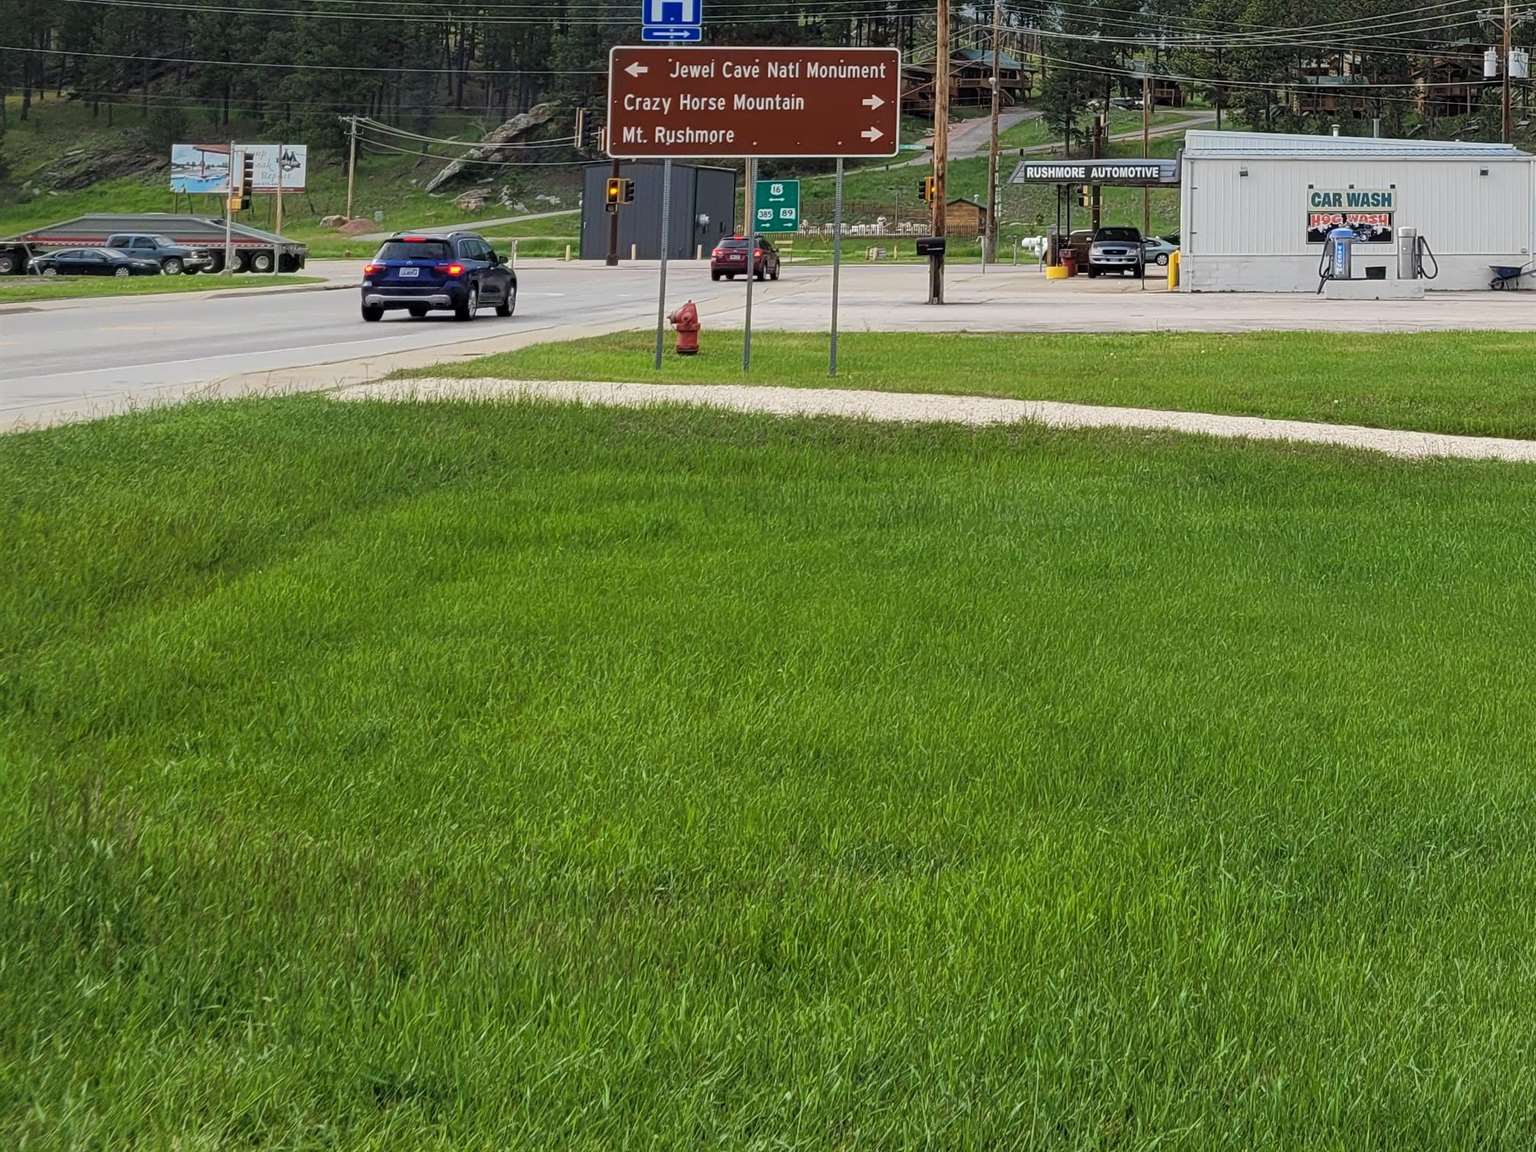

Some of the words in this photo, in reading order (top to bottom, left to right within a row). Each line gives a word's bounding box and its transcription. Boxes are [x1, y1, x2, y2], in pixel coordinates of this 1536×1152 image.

[669, 62, 715, 79] Jewel
[722, 62, 760, 79] Cave
[767, 61, 800, 79] Natl
[806, 62, 886, 79] Monument
[624, 94, 672, 115] Crazy
[679, 94, 726, 111] Horse
[733, 94, 805, 111] Mountain
[622, 127, 648, 144] Mt.
[655, 126, 735, 144] Rushmore
[1026, 166, 1086, 179] RUSHMORE
[1091, 166, 1160, 179] AUTOMOTIVE
[772, 185, 781, 193] 16
[1311, 192, 1343, 207] CAR
[1347, 192, 1392, 207] WASH
[759, 211, 772, 219] 385
[782, 209, 793, 217] 89
[1311, 214, 1344, 226] HOG
[1347, 214, 1389, 225] WASH
